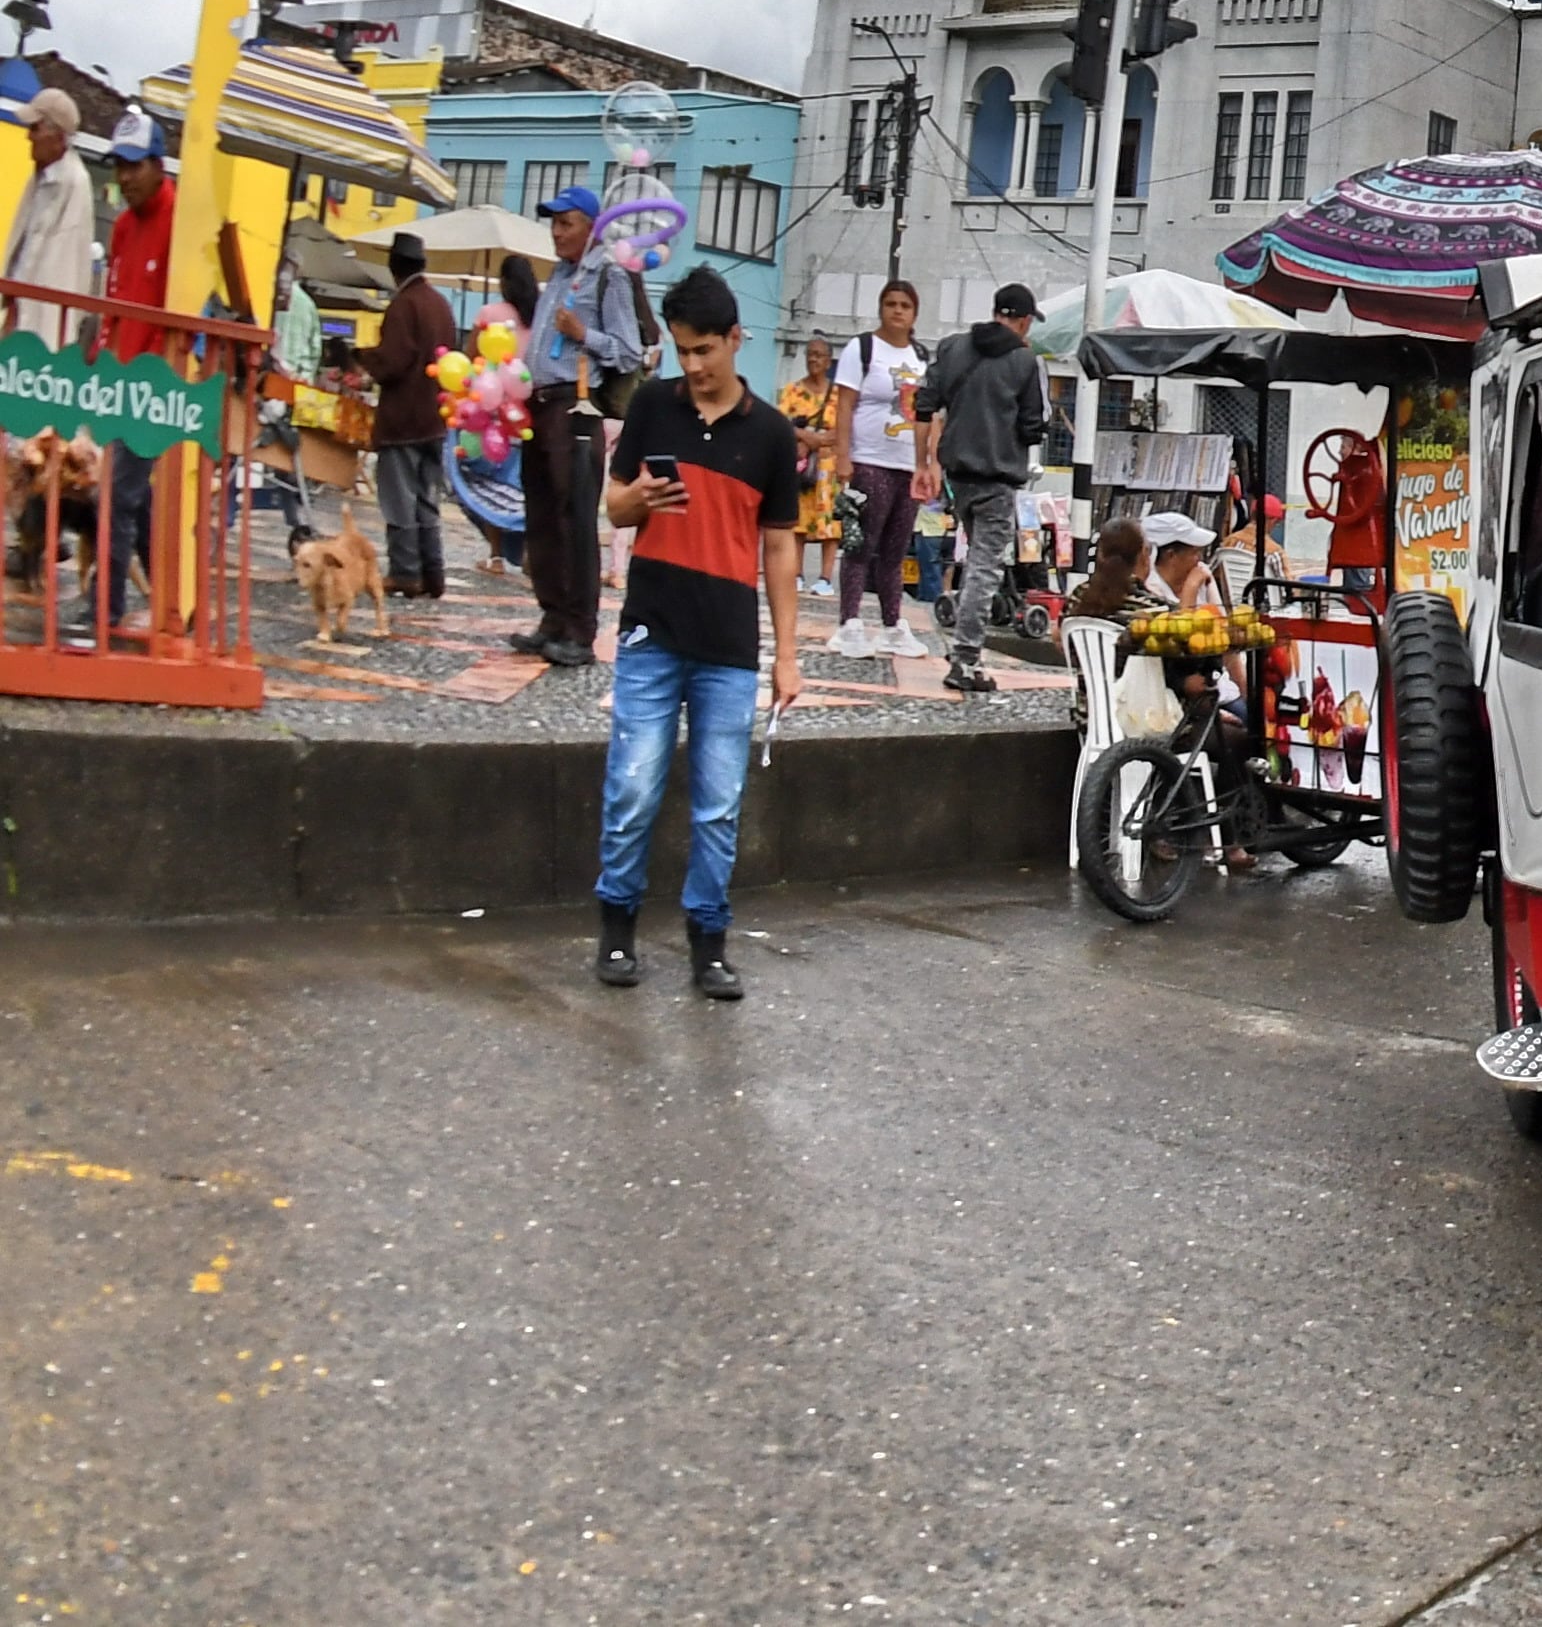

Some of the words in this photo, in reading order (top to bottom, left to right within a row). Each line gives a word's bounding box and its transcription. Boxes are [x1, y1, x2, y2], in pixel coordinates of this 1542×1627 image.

[78, 374, 125, 417] del
[129, 380, 204, 433] Valle
[1396, 440, 1453, 461] elicioso
[1398, 473, 1437, 506] jugo
[1443, 463, 1464, 492] de
[1431, 550, 1469, 571] $2.00
